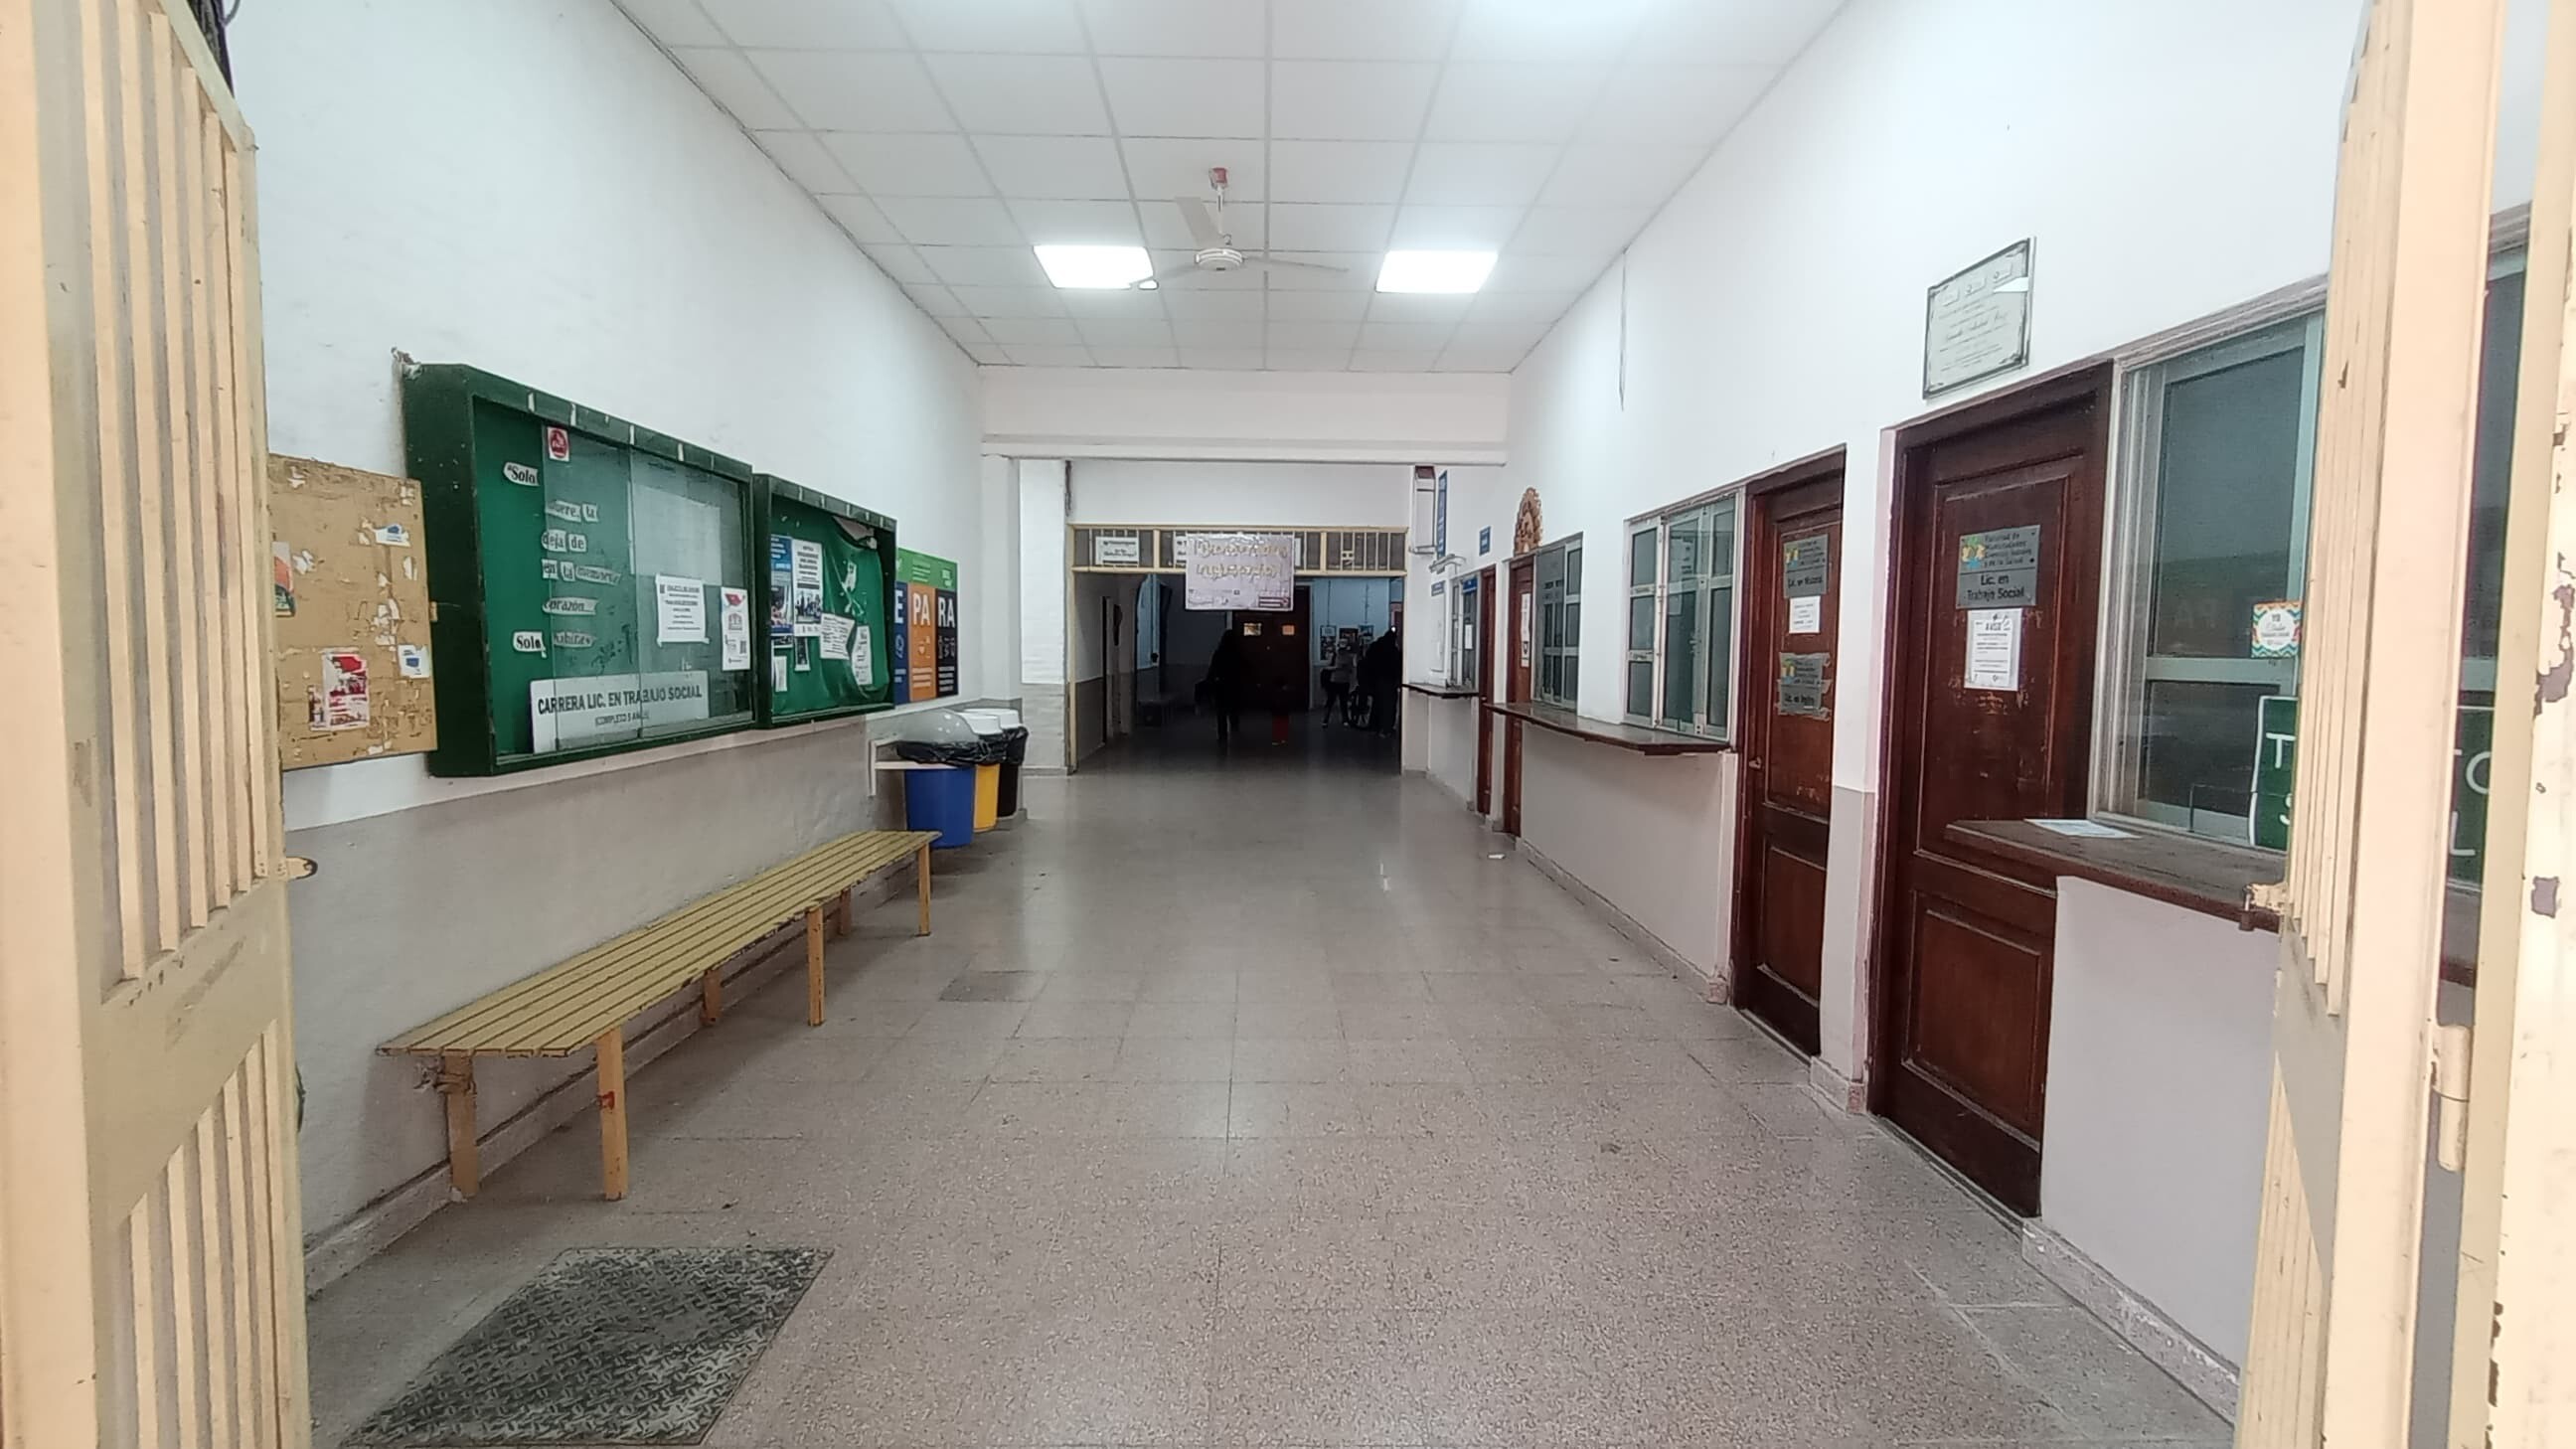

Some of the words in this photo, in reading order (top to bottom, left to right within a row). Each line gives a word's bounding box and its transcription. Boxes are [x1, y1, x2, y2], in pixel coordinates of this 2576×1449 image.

[570, 535, 584, 549] de
[1997, 586, 2024, 599] Social
[538, 695, 585, 715] CARRERA
[587, 693, 606, 709] LIC.
[608, 692, 621, 707] EN
[623, 688, 666, 706] TRABAJO
[668, 685, 703, 701] SOCIAL
